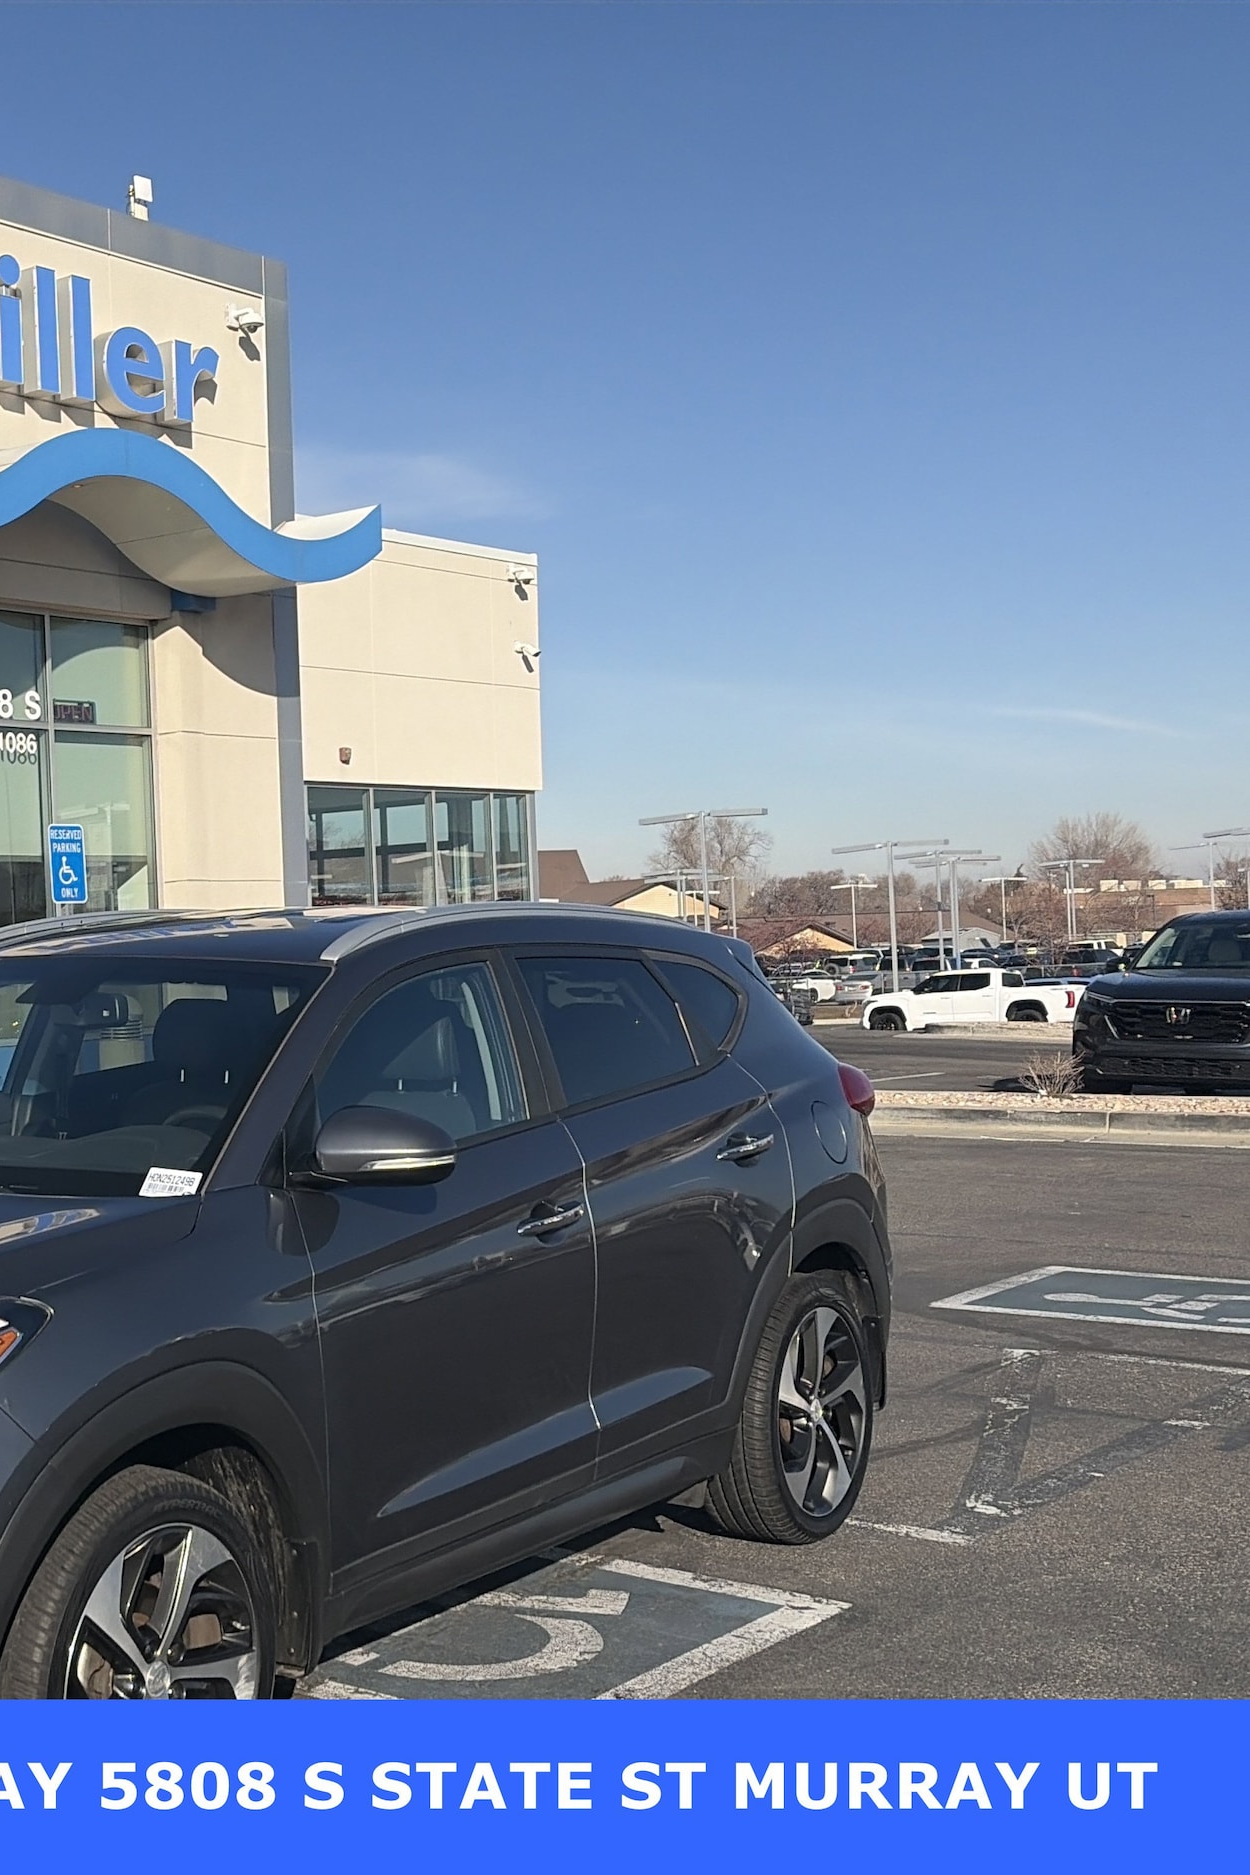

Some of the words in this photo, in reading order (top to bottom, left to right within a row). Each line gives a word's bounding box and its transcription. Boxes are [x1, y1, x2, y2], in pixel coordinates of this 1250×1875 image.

[24, 690, 42, 721] S
[50, 829, 82, 840] RESERVED
[52, 842, 82, 854] PARKING
[61, 887, 79, 899] ONLY
